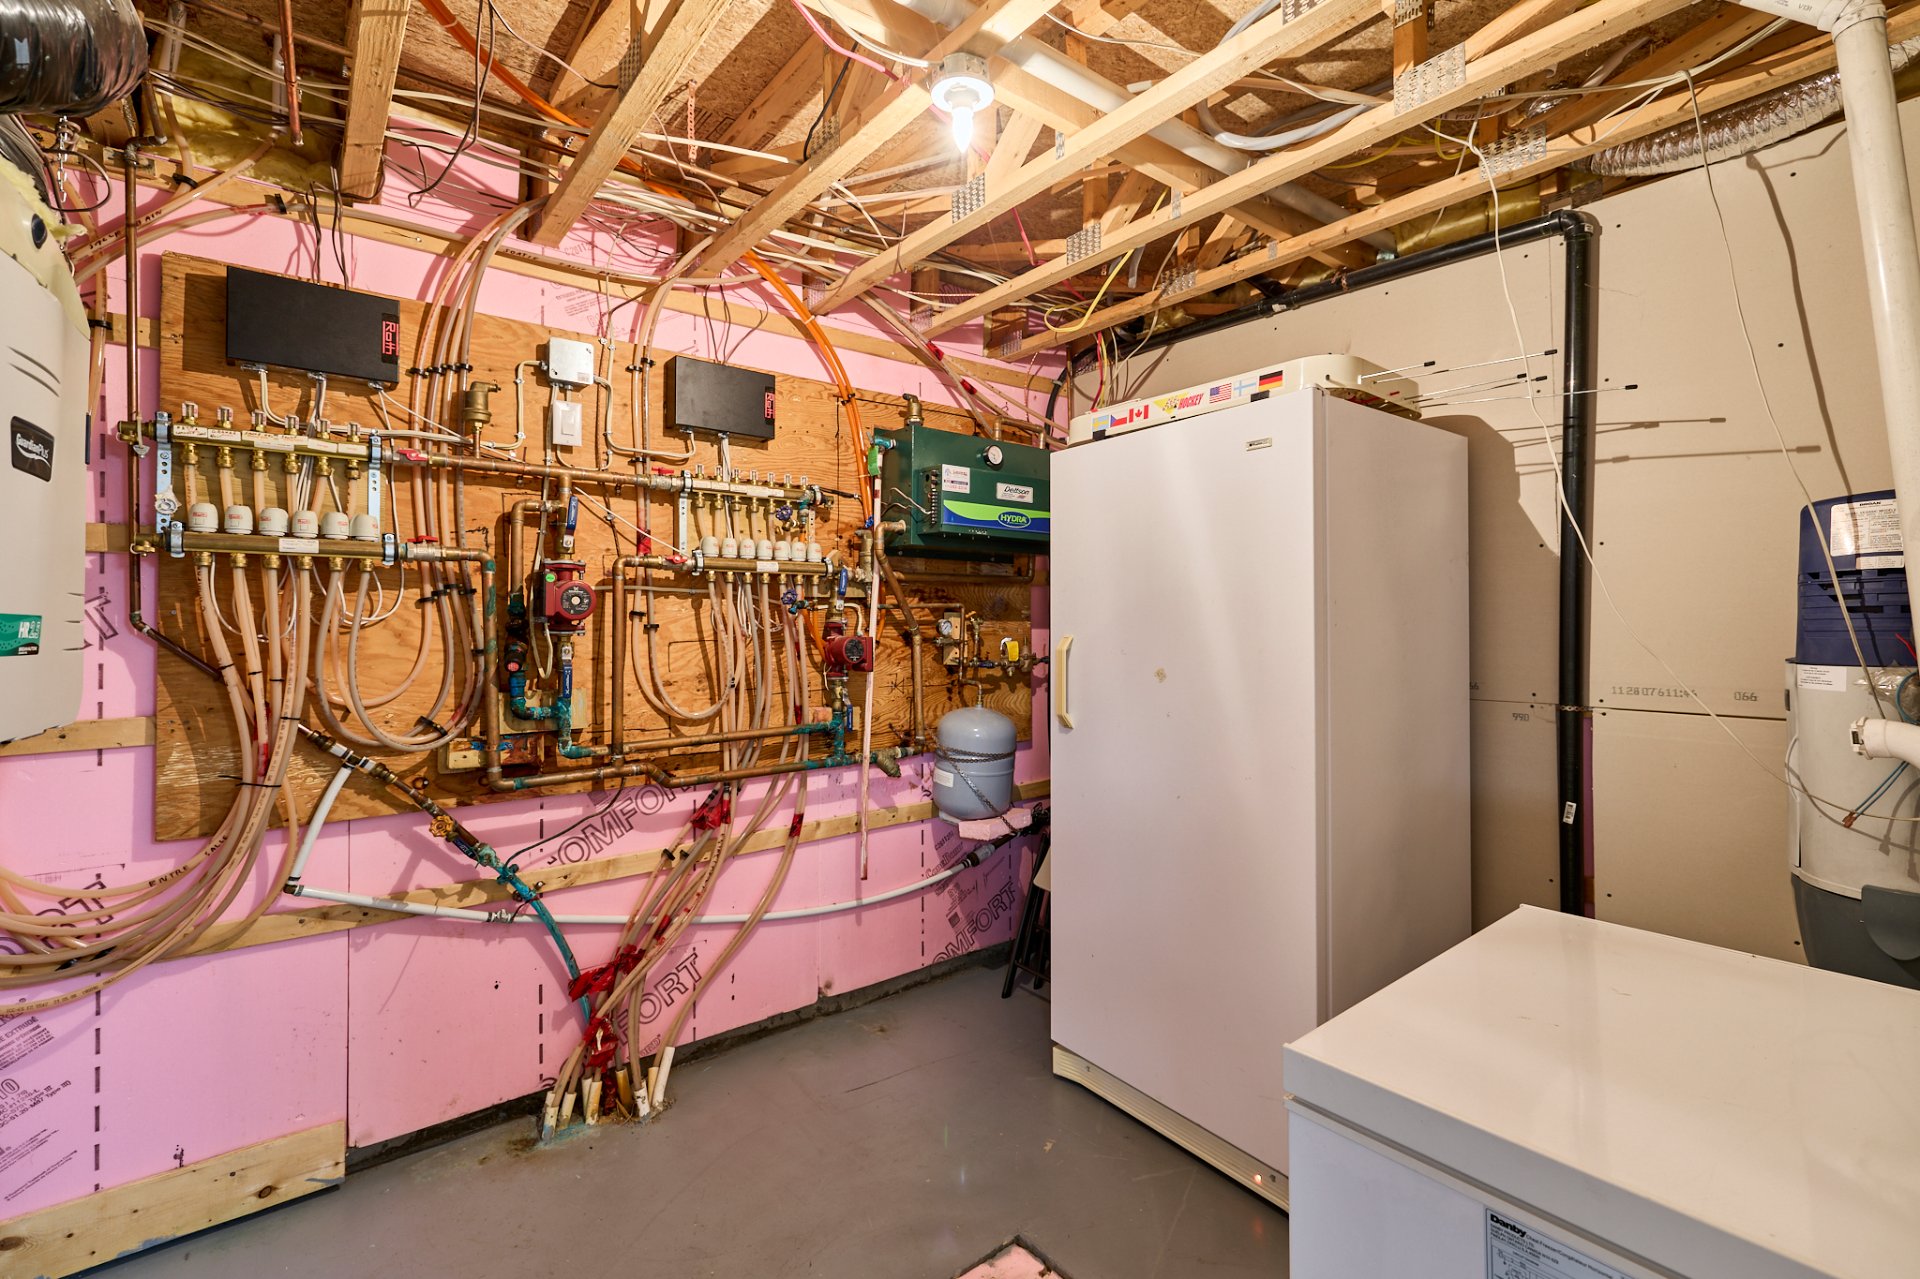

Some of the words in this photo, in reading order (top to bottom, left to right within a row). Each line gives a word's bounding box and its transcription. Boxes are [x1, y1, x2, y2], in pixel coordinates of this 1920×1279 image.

[1177, 392, 1204, 410] HOCKEY
[1000, 513, 1028, 525] HYDRA
[1490, 1213, 1527, 1238] Danby
